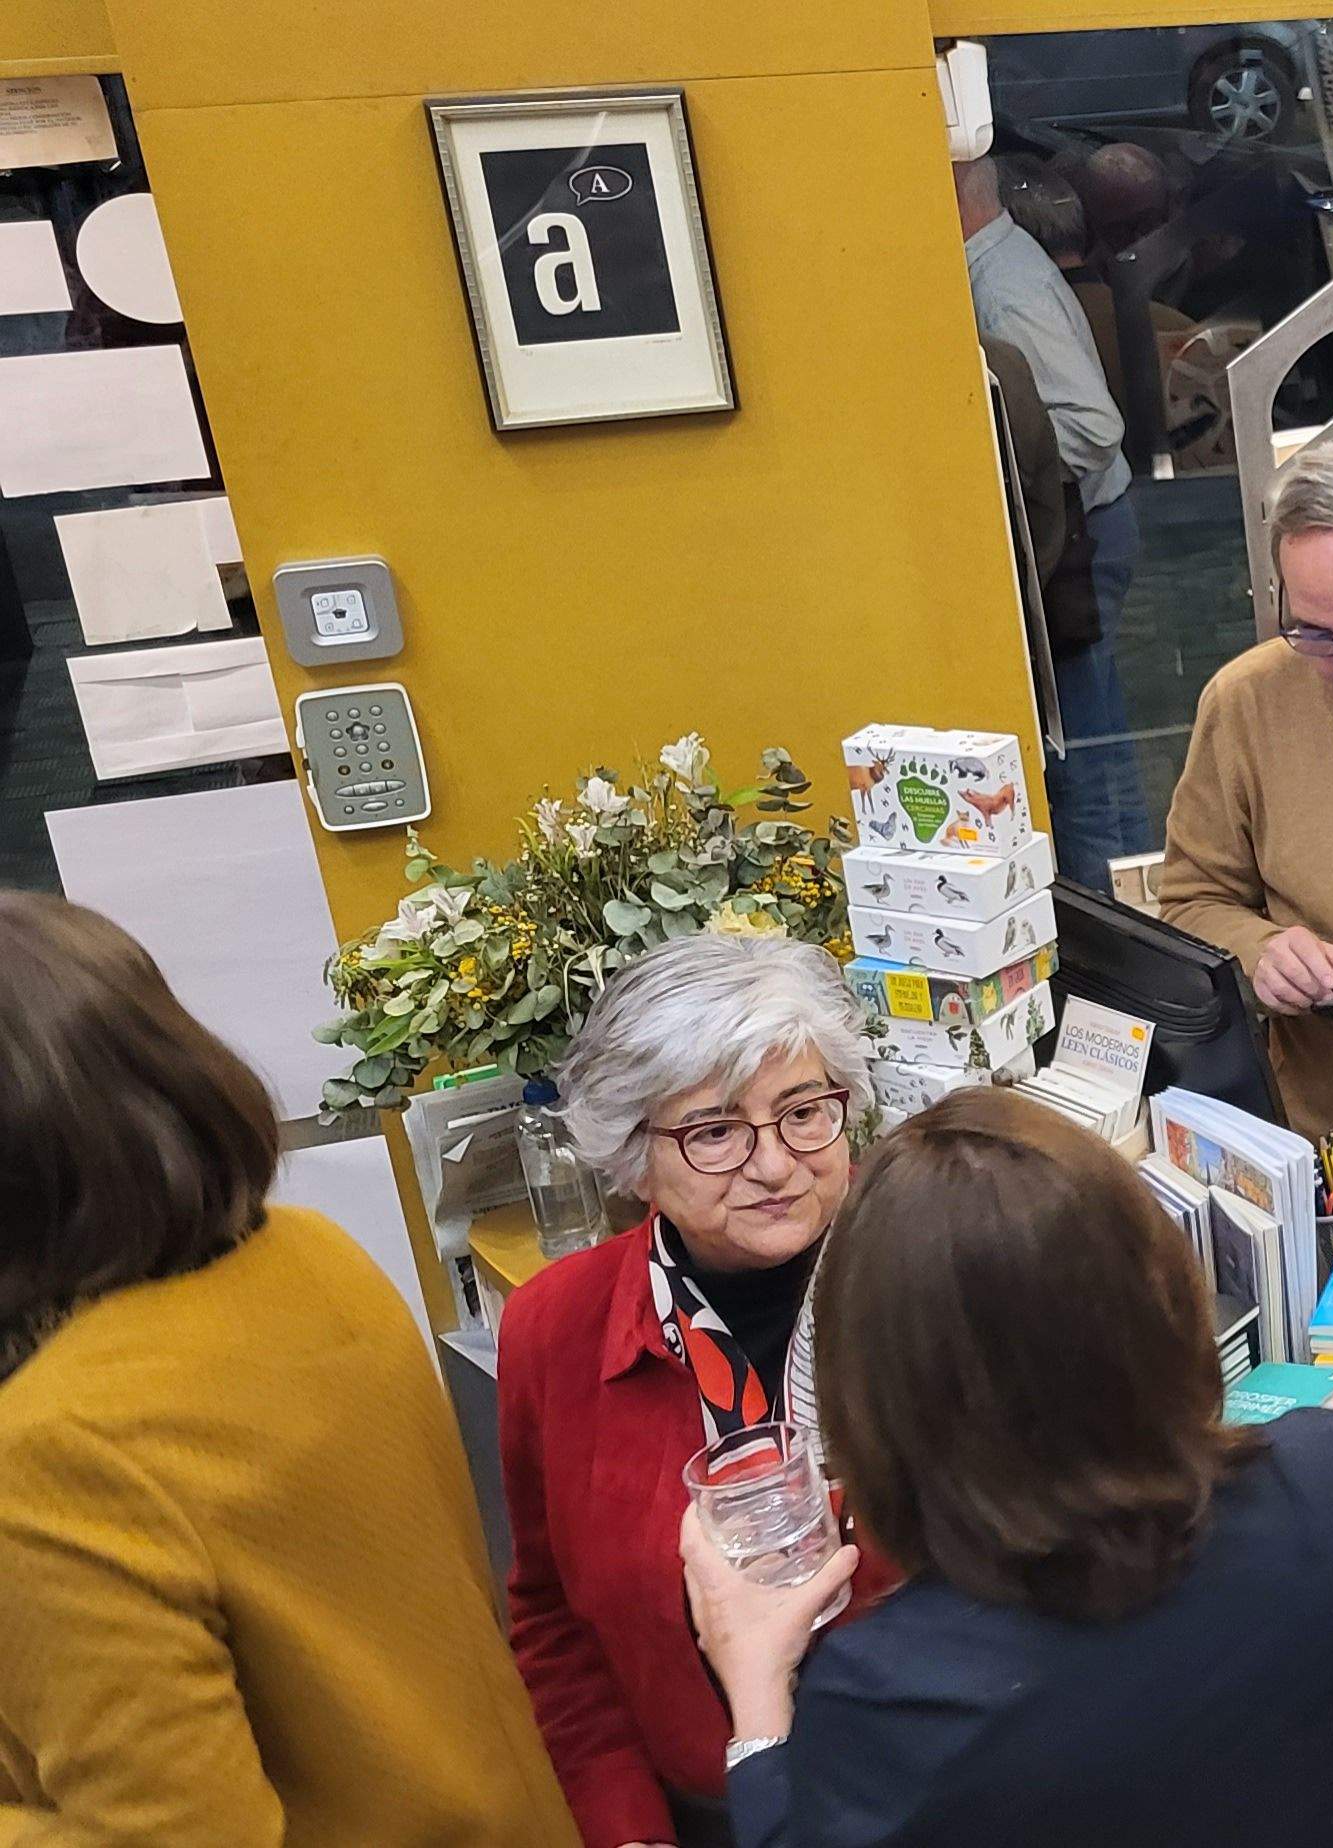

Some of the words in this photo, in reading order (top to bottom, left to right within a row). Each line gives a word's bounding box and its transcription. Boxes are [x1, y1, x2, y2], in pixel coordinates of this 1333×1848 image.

[527, 212, 602, 316] a
[904, 786, 941, 797] DESCUBRE
[918, 796, 948, 807] HUELLAS
[1061, 1036, 1087, 1056] LEEN
[1089, 1046, 1138, 1073] CLÁSICOS
[1066, 1024, 1084, 1038] LOS
[1085, 1031, 1140, 1059] MODERNOS
